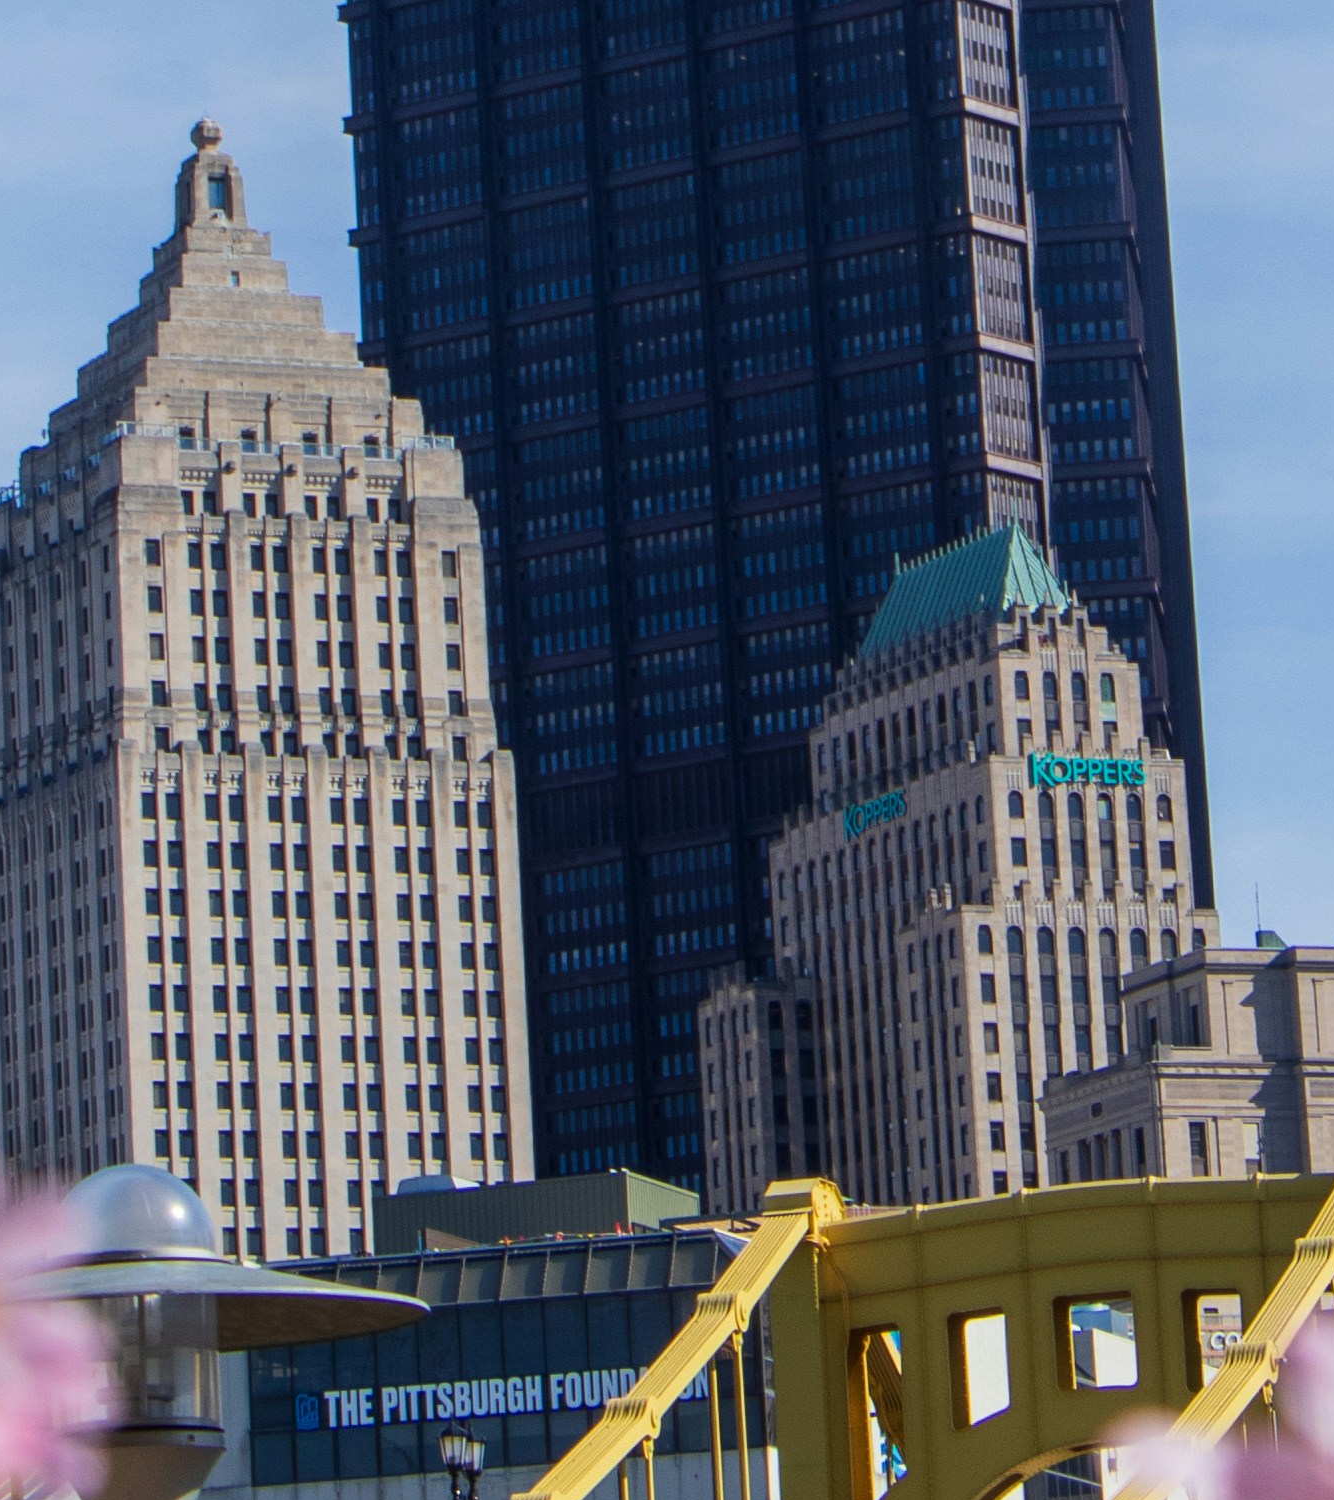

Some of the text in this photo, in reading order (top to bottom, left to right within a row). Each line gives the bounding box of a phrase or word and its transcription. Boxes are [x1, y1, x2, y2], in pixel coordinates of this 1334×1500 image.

[1030, 751, 1147, 787] KOPPERS
[843, 788, 907, 842] KOPPERS
[324, 1363, 709, 1428] THE PITTSBURGH FOUNDN
